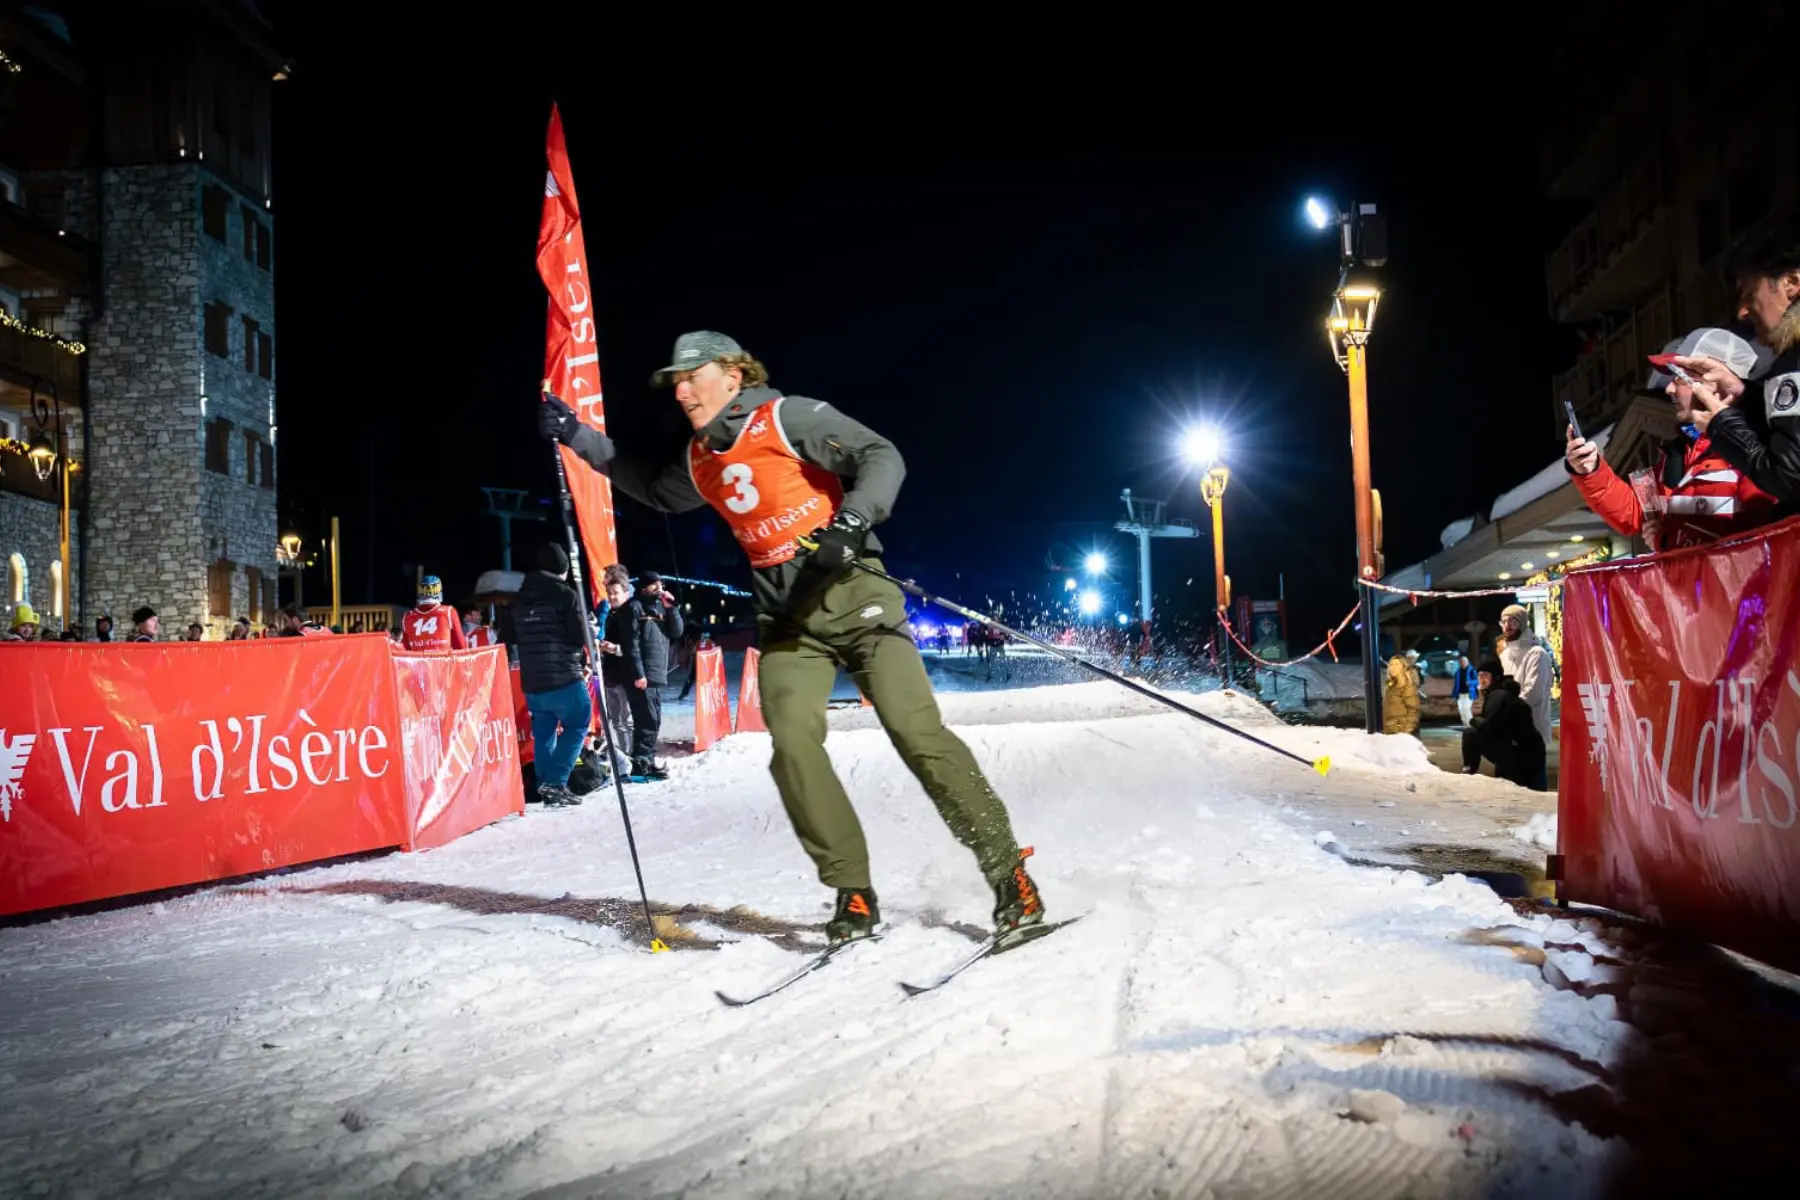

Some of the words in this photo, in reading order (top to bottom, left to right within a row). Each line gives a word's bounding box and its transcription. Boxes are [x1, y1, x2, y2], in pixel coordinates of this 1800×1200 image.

[721, 463, 760, 514] 3
[757, 496, 820, 538] d'Isère
[413, 616, 438, 636] 14
[47, 724, 168, 817] Val
[192, 708, 389, 802] d'Isère
[1692, 669, 1800, 829] d'Is
